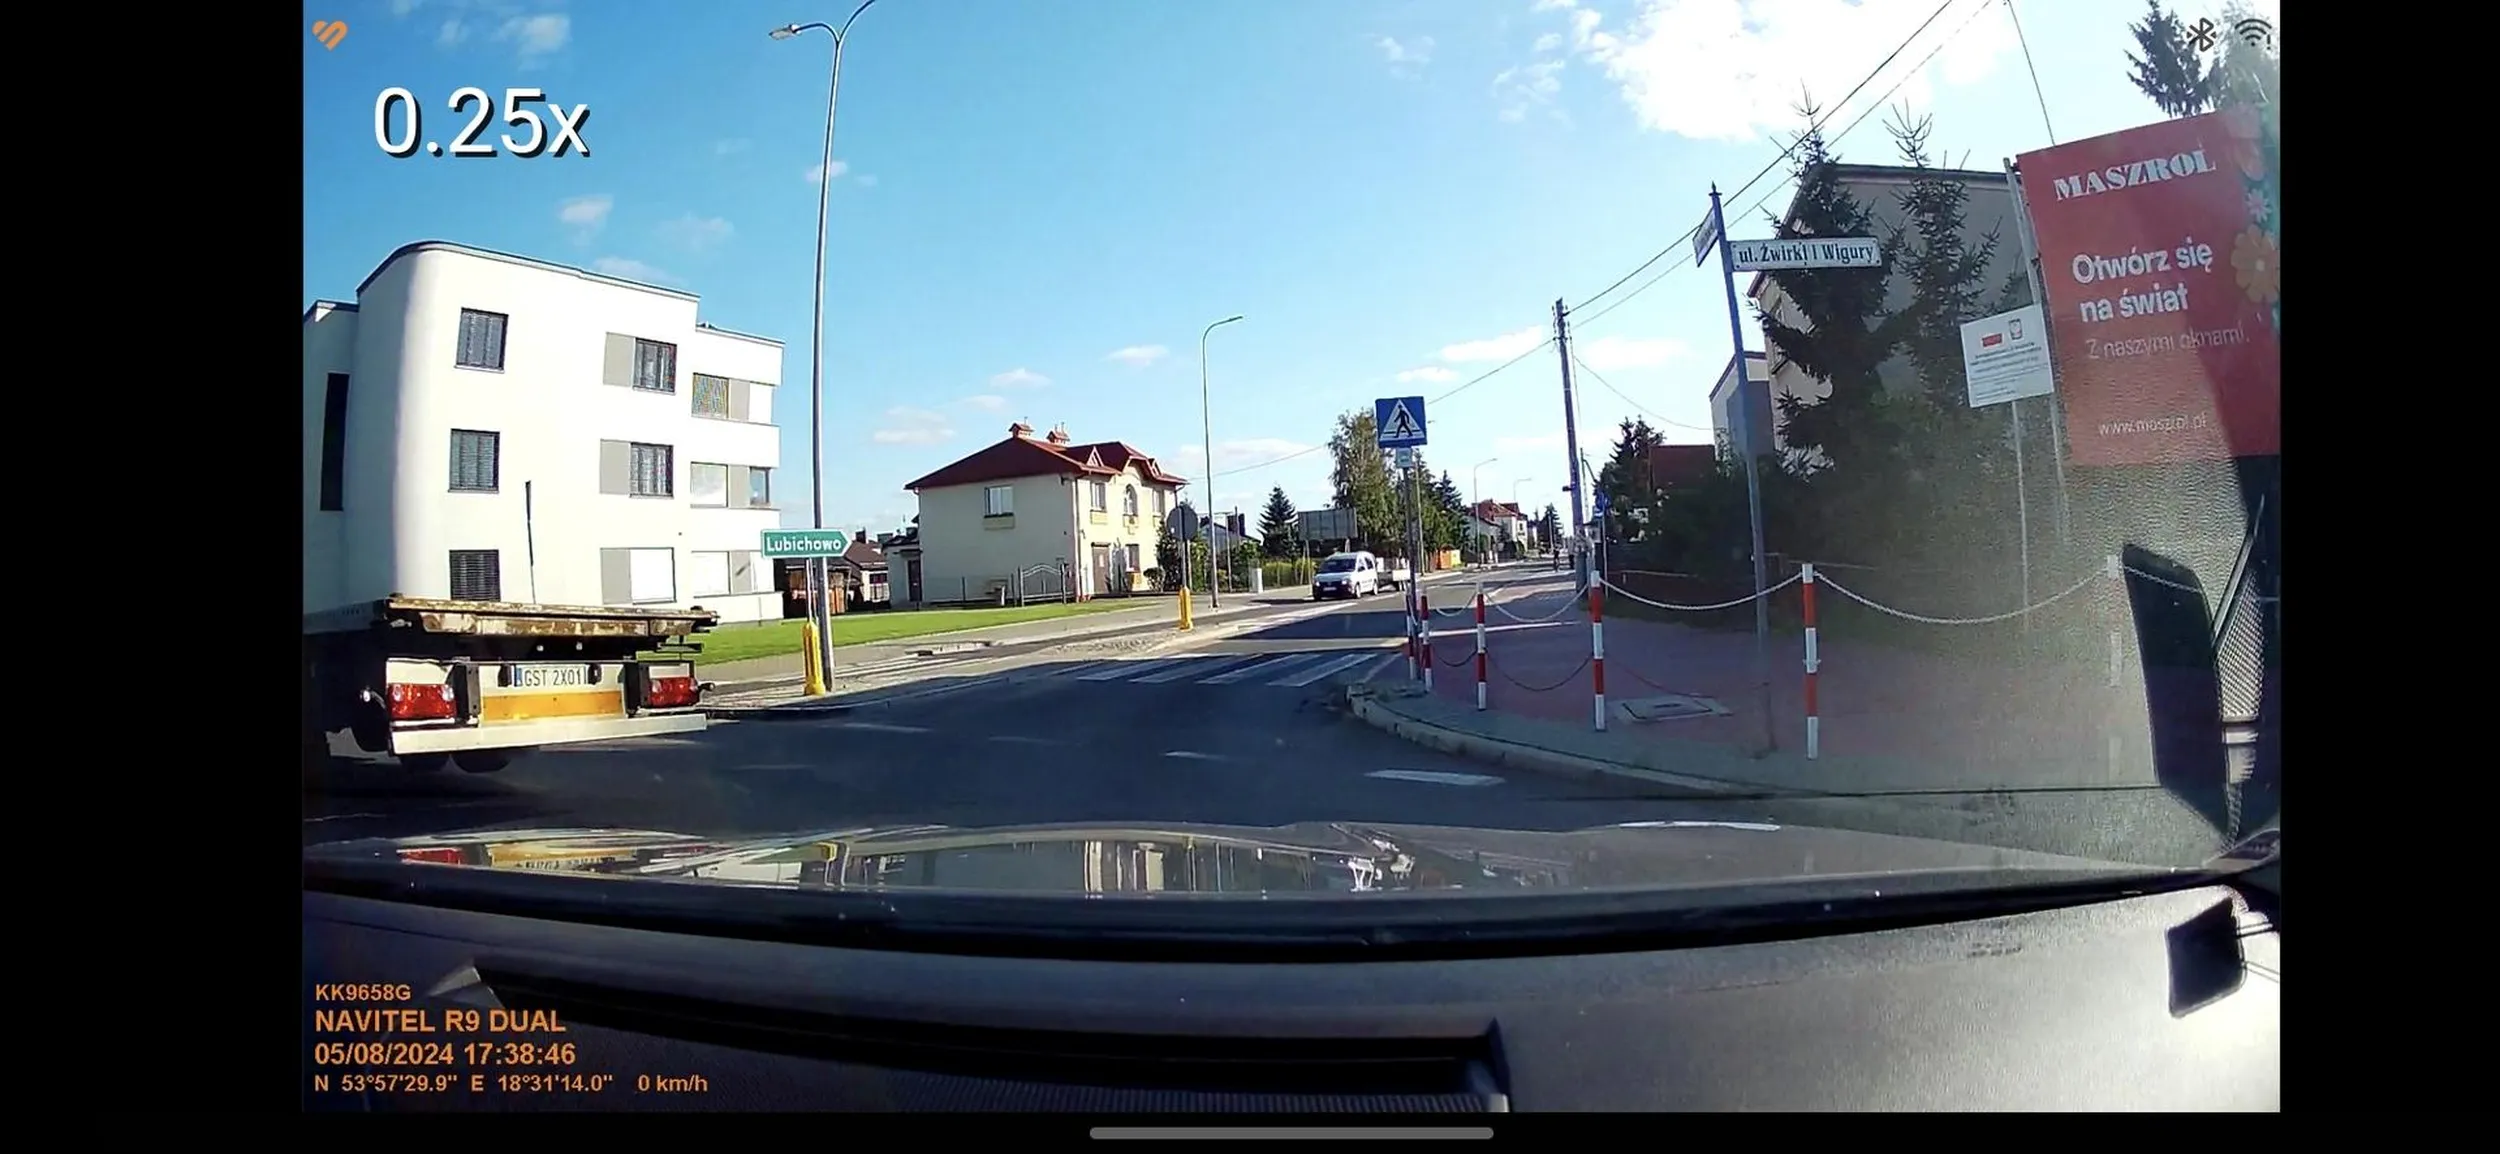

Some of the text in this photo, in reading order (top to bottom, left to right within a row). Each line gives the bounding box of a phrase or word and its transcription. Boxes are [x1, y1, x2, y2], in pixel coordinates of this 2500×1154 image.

[1739, 246, 1758, 263] ul.
[1822, 242, 1874, 265] Wigury
[2072, 235, 2213, 284] Otwórz się
[2080, 282, 2189, 323] na świat
[766, 535, 841, 552] Lubichowo
[524, 669, 547, 687] GST
